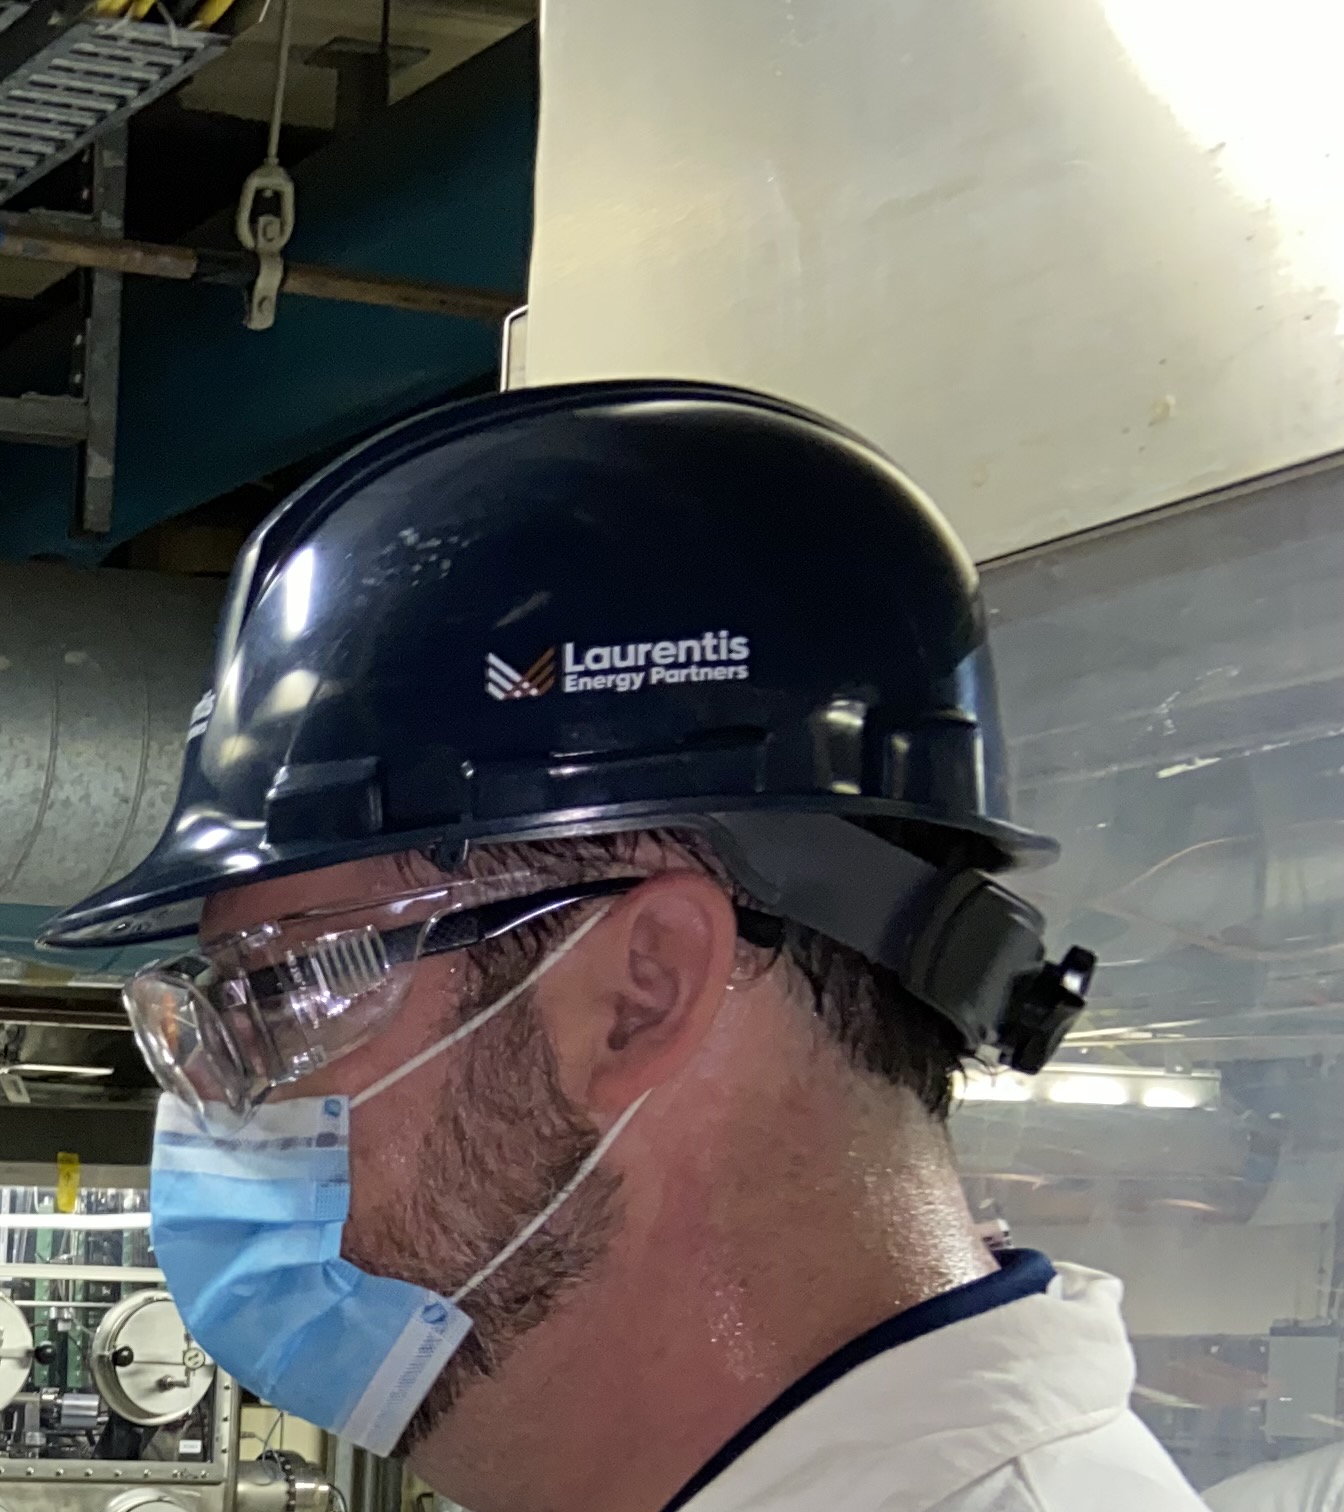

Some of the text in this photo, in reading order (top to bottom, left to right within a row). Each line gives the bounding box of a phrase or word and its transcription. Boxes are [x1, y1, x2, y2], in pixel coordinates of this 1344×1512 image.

[564, 629, 750, 673] Laurentis
[564, 664, 749, 692] Energy Partners
